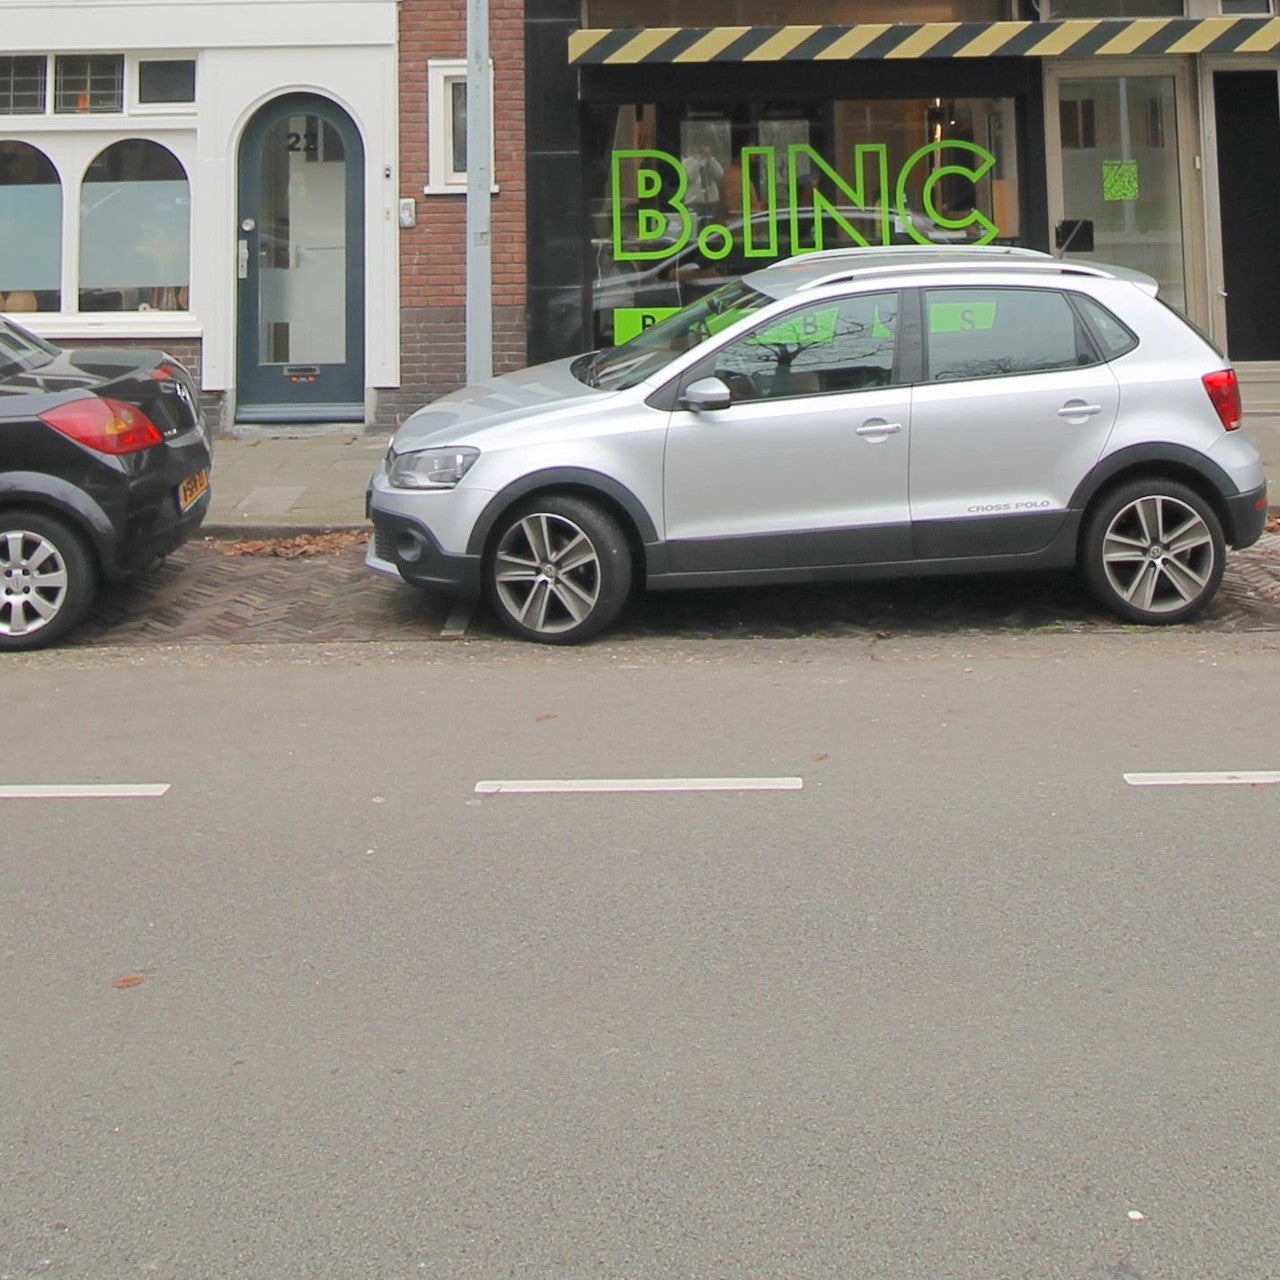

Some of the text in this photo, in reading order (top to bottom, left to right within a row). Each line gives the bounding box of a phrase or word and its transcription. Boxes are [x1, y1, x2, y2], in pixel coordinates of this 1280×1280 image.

[611, 139, 1000, 261] B.INC
[967, 500, 1050, 513] CROSS POLO
